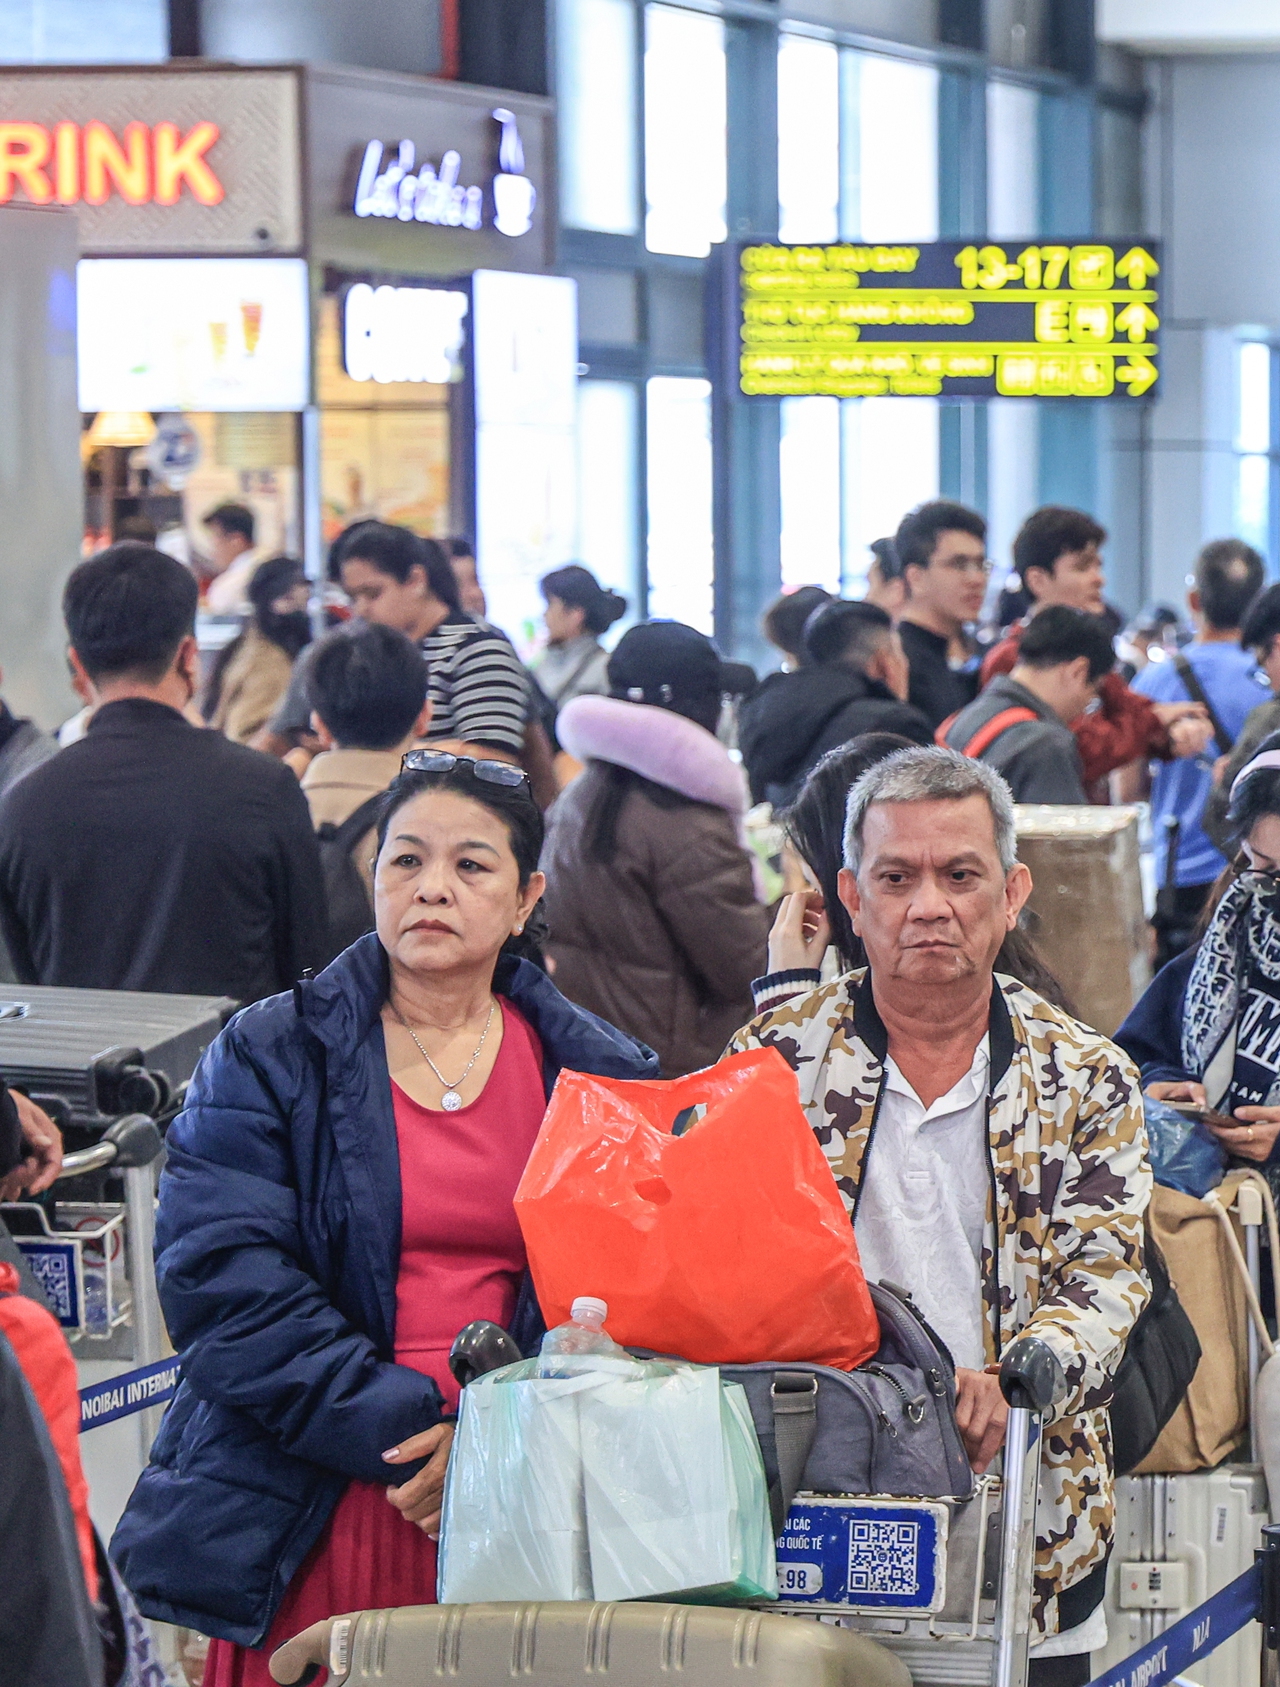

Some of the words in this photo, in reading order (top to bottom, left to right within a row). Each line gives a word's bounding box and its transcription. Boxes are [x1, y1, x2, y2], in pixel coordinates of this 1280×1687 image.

[0, 119, 225, 206] RINK
[954, 245, 1071, 290] 13-17
[81, 1386, 125, 1421] NOIBAI
[776, 1569, 807, 1589] .98
